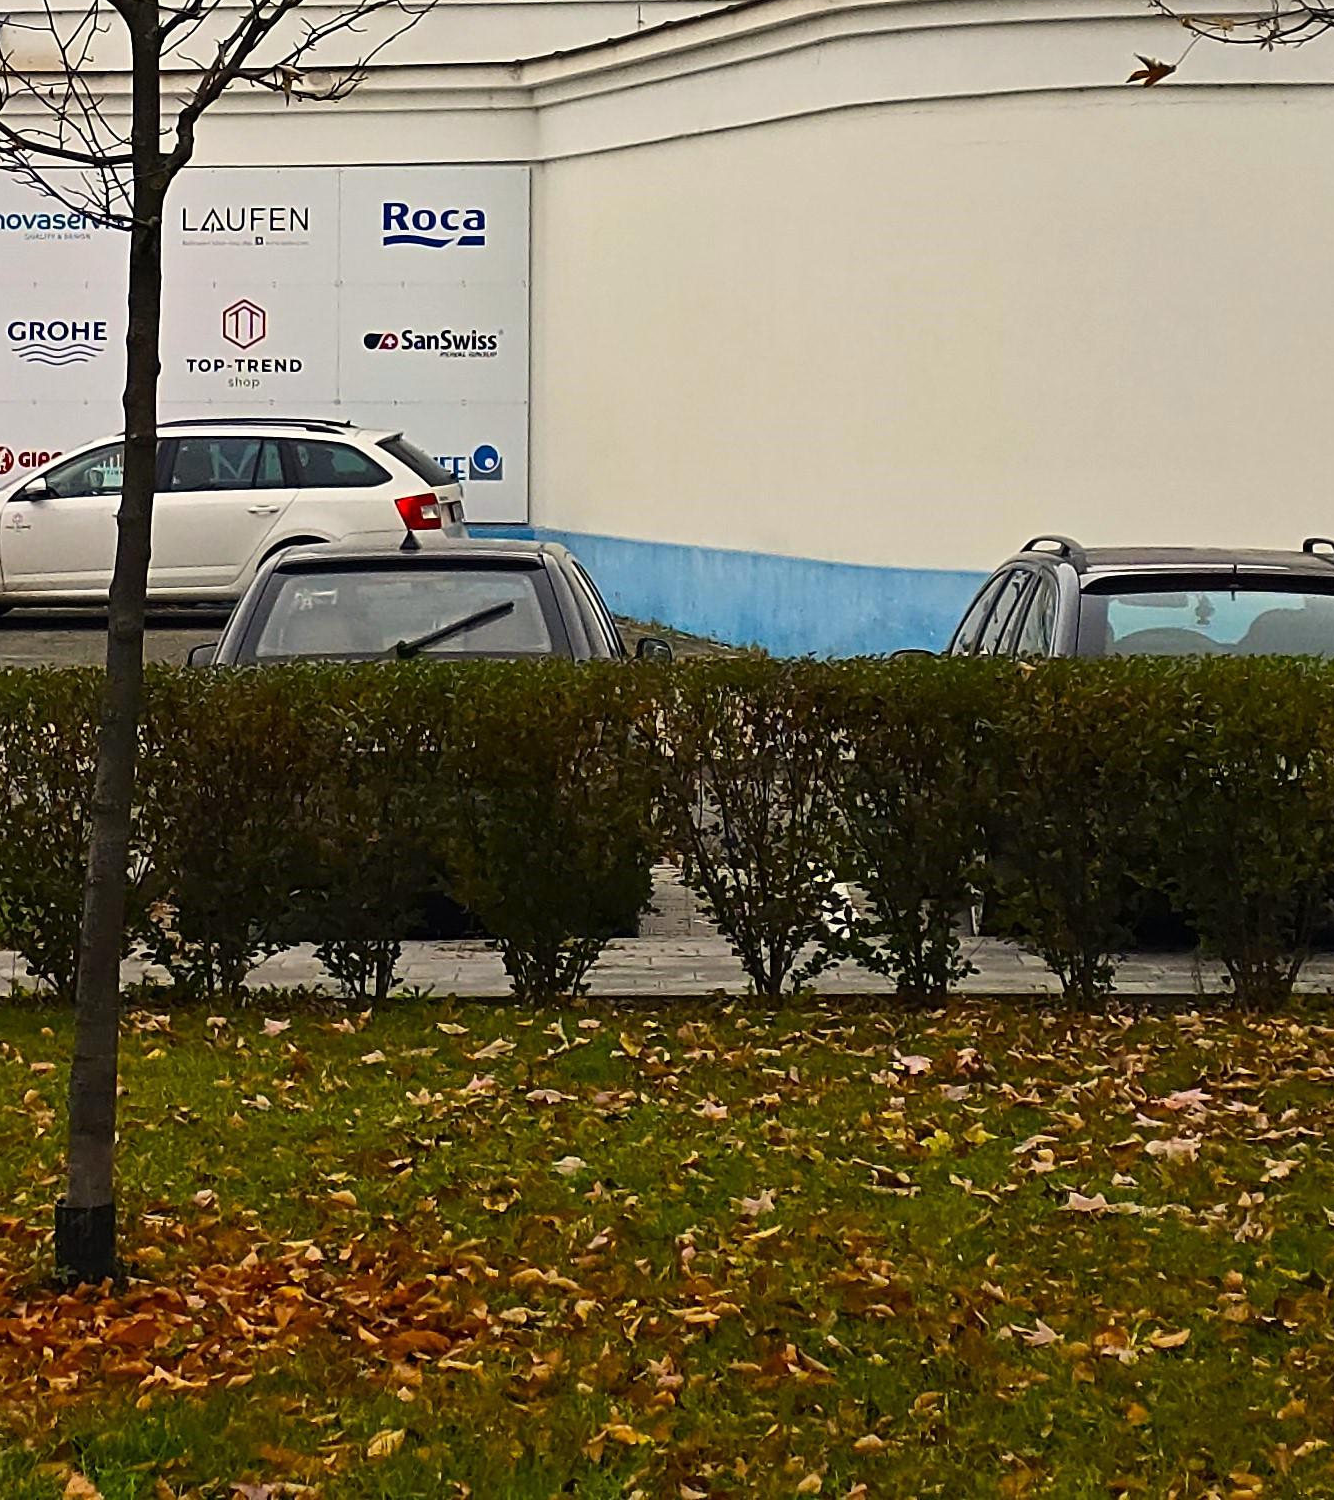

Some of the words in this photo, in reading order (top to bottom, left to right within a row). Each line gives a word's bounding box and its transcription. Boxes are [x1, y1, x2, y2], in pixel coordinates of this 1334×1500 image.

[182, 207, 309, 232] LAUFEN
[382, 202, 485, 231] Roca
[7, 321, 108, 341] GROHE
[401, 329, 497, 350] SanSwiss
[186, 359, 303, 373] TOP-TREND
[227, 377, 261, 389] shop
